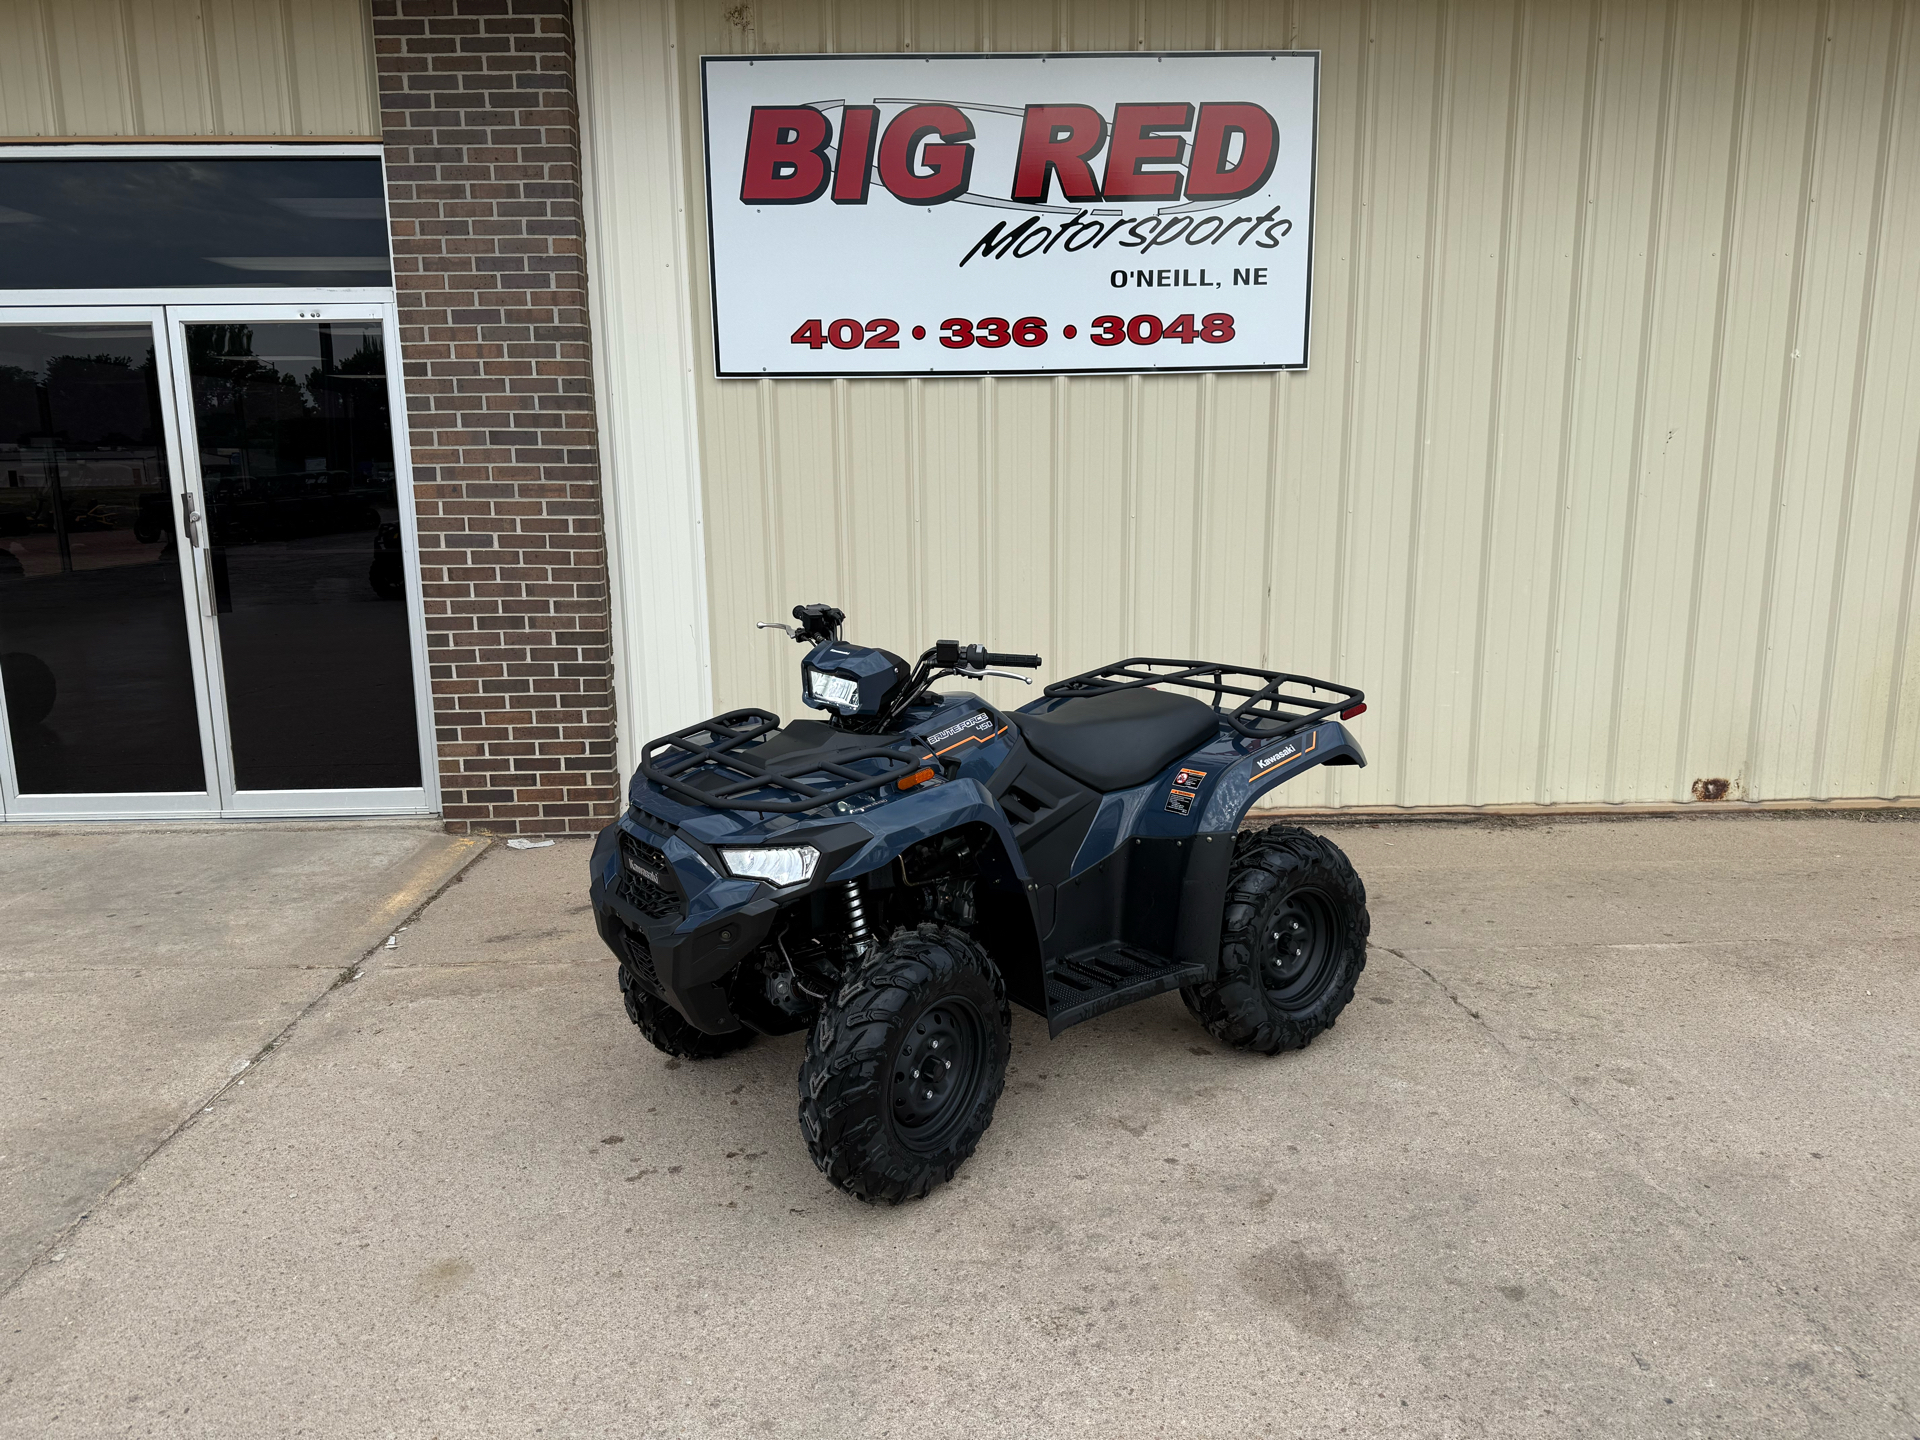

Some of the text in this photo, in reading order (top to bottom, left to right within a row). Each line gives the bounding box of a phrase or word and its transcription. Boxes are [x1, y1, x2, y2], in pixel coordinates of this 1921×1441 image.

[740, 101, 1280, 206] BIG RED
[959, 205, 1293, 268] Motorsports
[1110, 267, 1269, 290] O'NEILL, NE
[790, 312, 1236, 350] 402 336 3048
[975, 720, 994, 731] 450
[1256, 744, 1296, 768] Kawasaki
